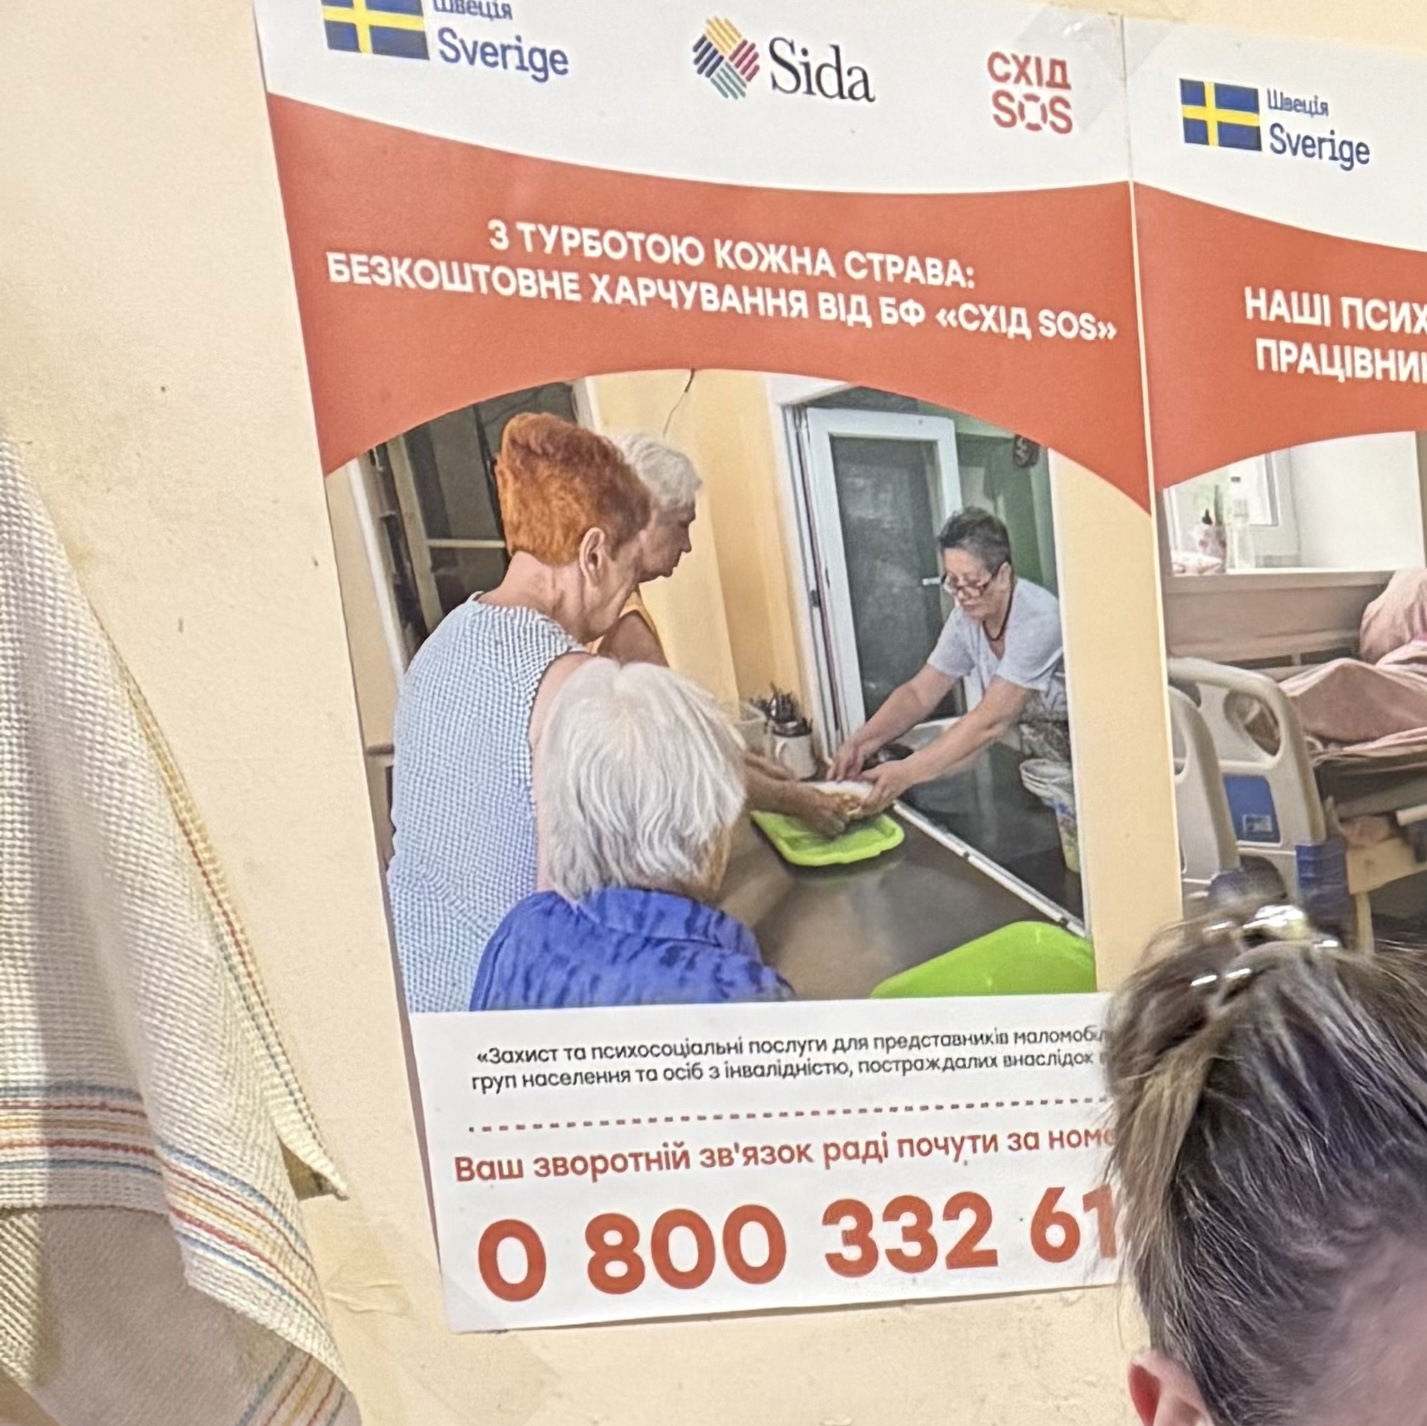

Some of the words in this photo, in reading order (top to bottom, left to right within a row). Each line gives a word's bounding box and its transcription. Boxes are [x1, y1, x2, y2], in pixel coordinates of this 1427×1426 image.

[438, 27, 569, 83] Sverige
[769, 37, 876, 102] Sida
[986, 50, 1071, 90] СХІД
[992, 90, 1074, 135] SOS
[1269, 124, 1370, 171] Sverige
[489, 219, 508, 251] З
[517, 223, 705, 267] ТУРБОТОЮ
[715, 237, 835, 278] КОЖНА
[845, 251, 975, 290] СТРАВА:
[326, 252, 581, 304] БЕЗКОШТОВНЕ
[591, 274, 808, 321] ХАРЧУВАННЯ
[818, 290, 873, 329] ВІД
[880, 292, 925, 327] БФ
[936, 302, 1032, 341] «СХІД
[1038, 308, 1117, 343] SOS»
[1245, 286, 1330, 327] НАШІ
[476, 1046, 557, 1064] «Захист
[563, 1046, 586, 1061] та
[591, 1036, 743, 1062] психосоціальні
[749, 1035, 827, 1055] послуги
[832, 1035, 869, 1053] для
[874, 1026, 1008, 1053] представників
[1013, 1023, 1104, 1045] маломоб
[471, 1073, 517, 1094] груп
[522, 1068, 631, 1088] населення
[635, 1067, 658, 1082] та
[663, 1062, 703, 1081] осіб
[708, 1065, 720, 1079] з
[725, 1057, 853, 1079] інвалідністю,
[858, 1055, 998, 1077] постраждалих
[1003, 1048, 1094, 1069] внаслідок
[454, 1153, 524, 1182] Ваш
[533, 1139, 691, 1182] зворотній
[823, 1131, 888, 1170] раді
[897, 1128, 998, 1164] почути
[1007, 1127, 1040, 1153] за
[1048, 1127, 1116, 1150] номе
[478, 1219, 546, 1302] 0
[584, 1204, 787, 1295] 800
[822, 1192, 999, 1278] 332
[1030, 1184, 1117, 1263] 61
